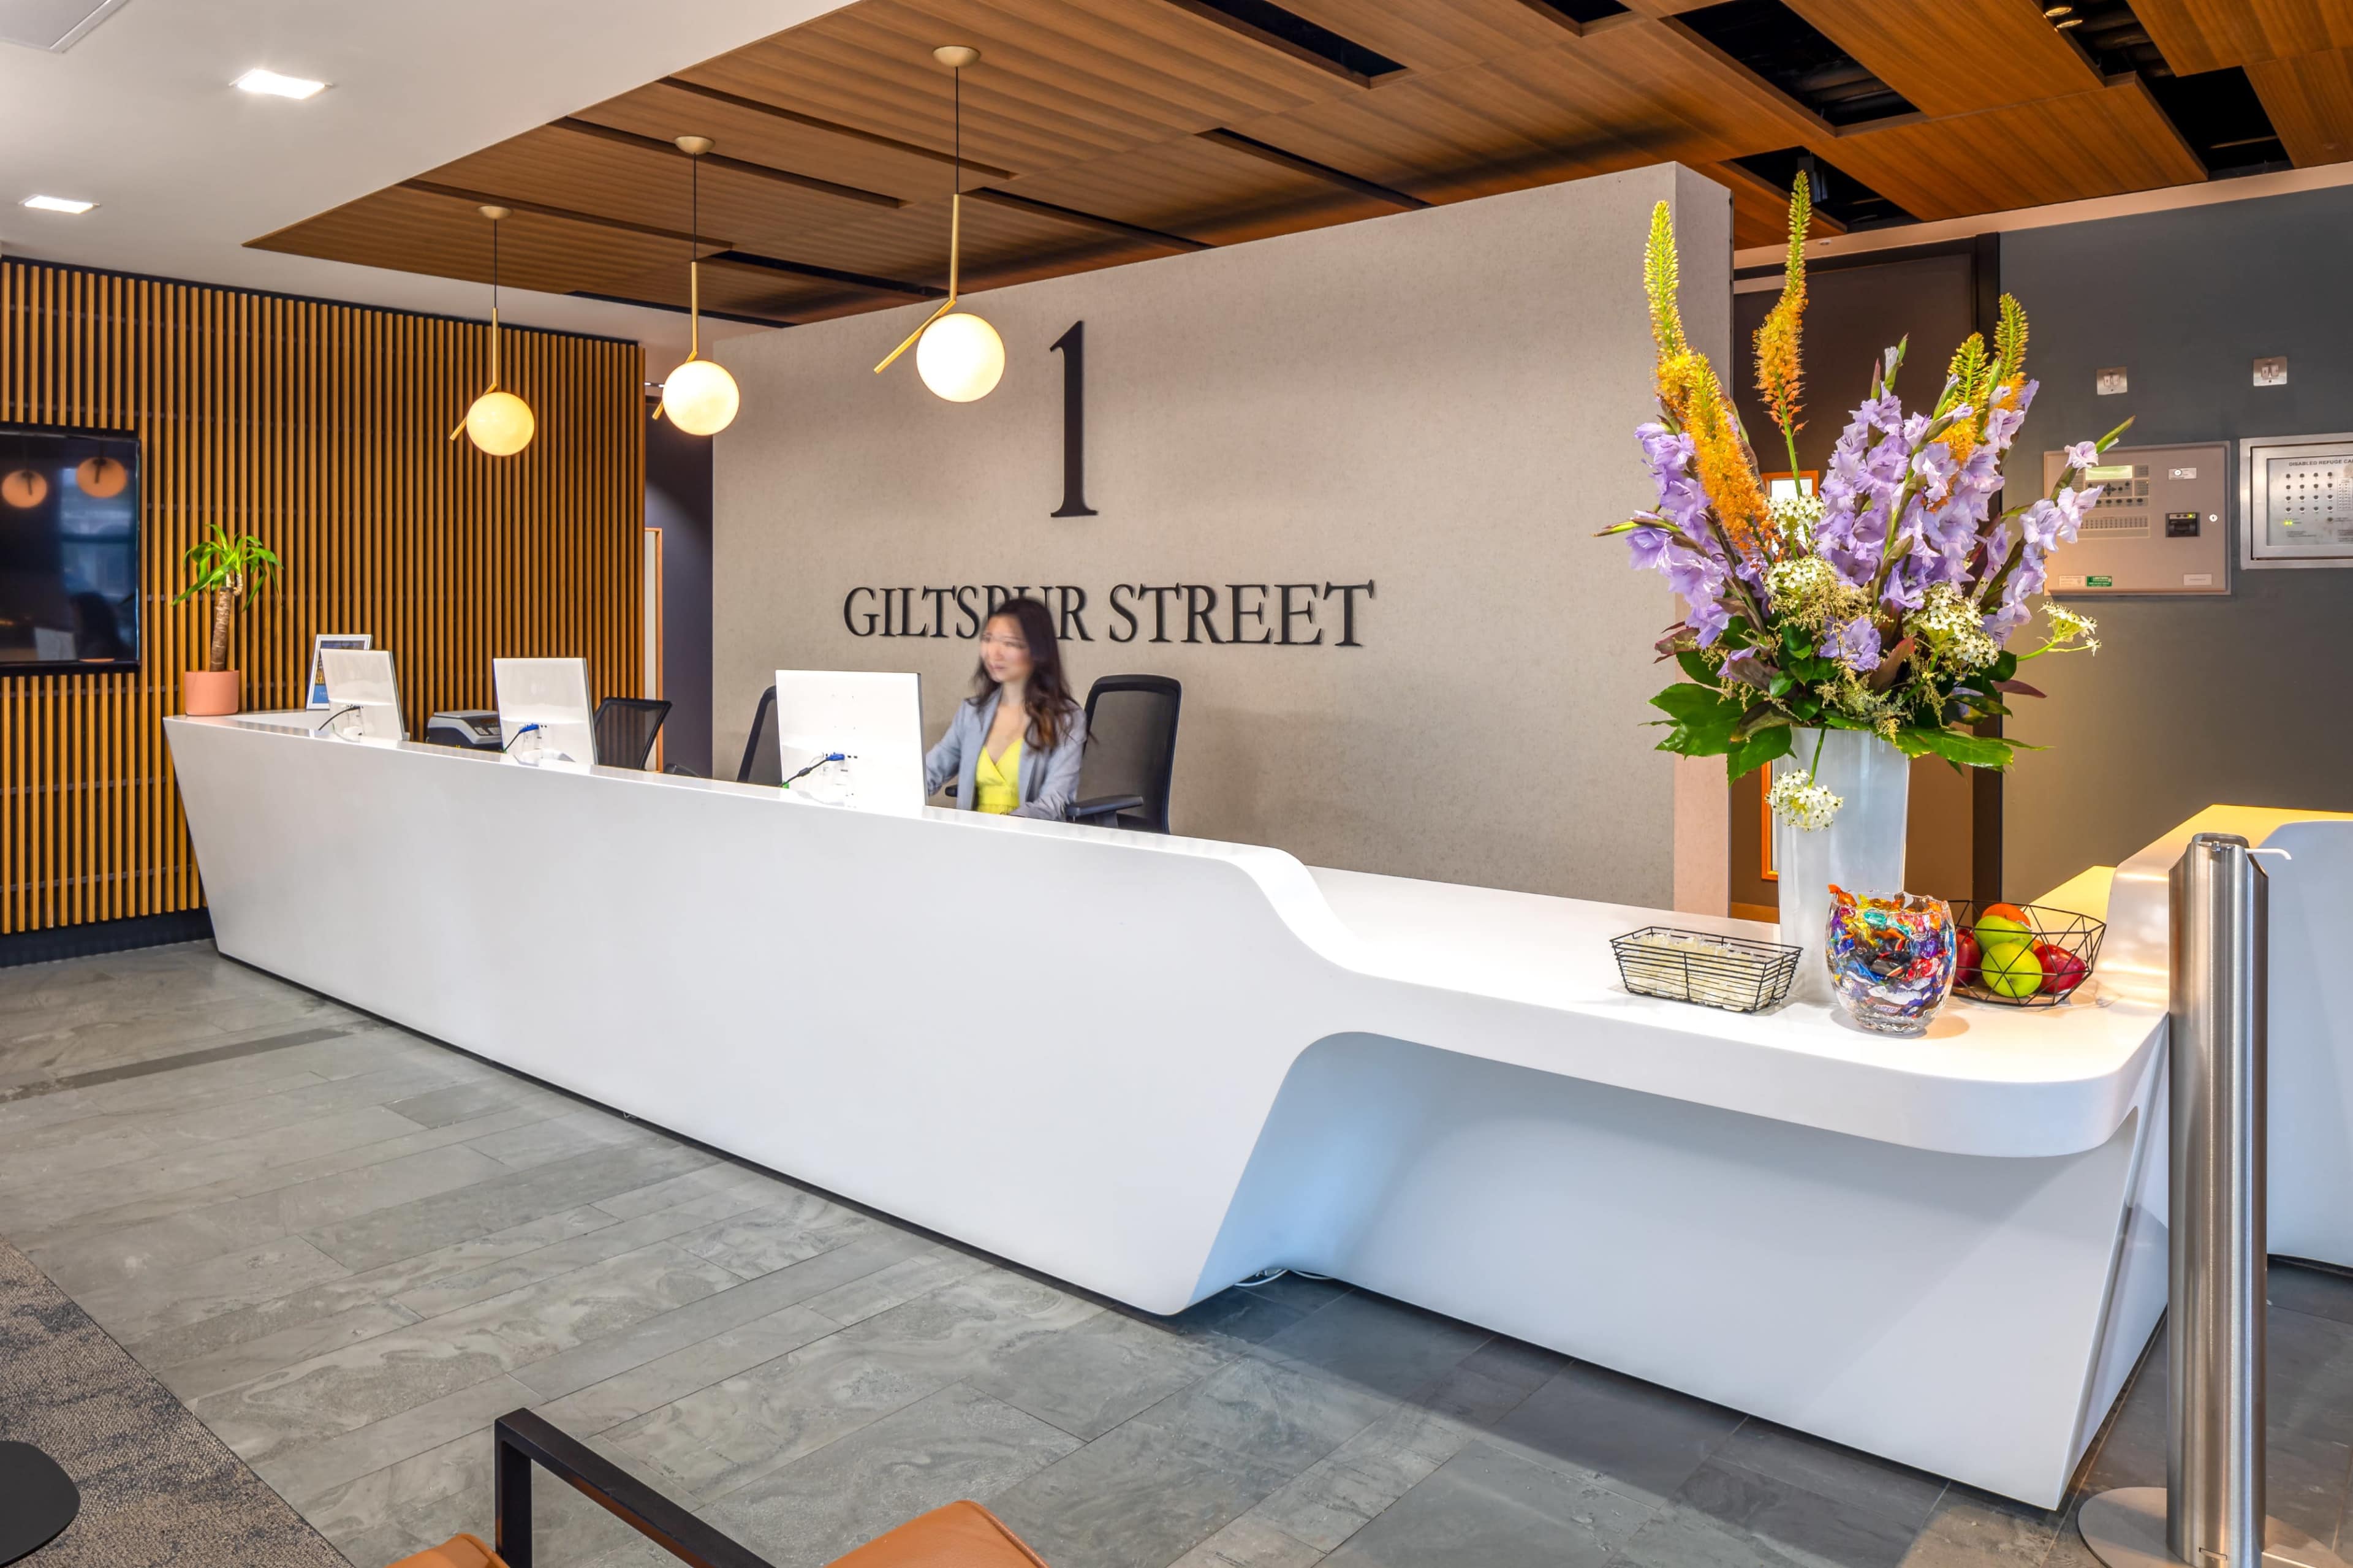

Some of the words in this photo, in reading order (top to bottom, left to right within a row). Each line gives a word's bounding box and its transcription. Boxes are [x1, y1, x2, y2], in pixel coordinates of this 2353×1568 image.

[1049, 320, 1099, 518] 1
[843, 585, 1095, 642] GILTSPR
[1108, 579, 1375, 648] STREET
